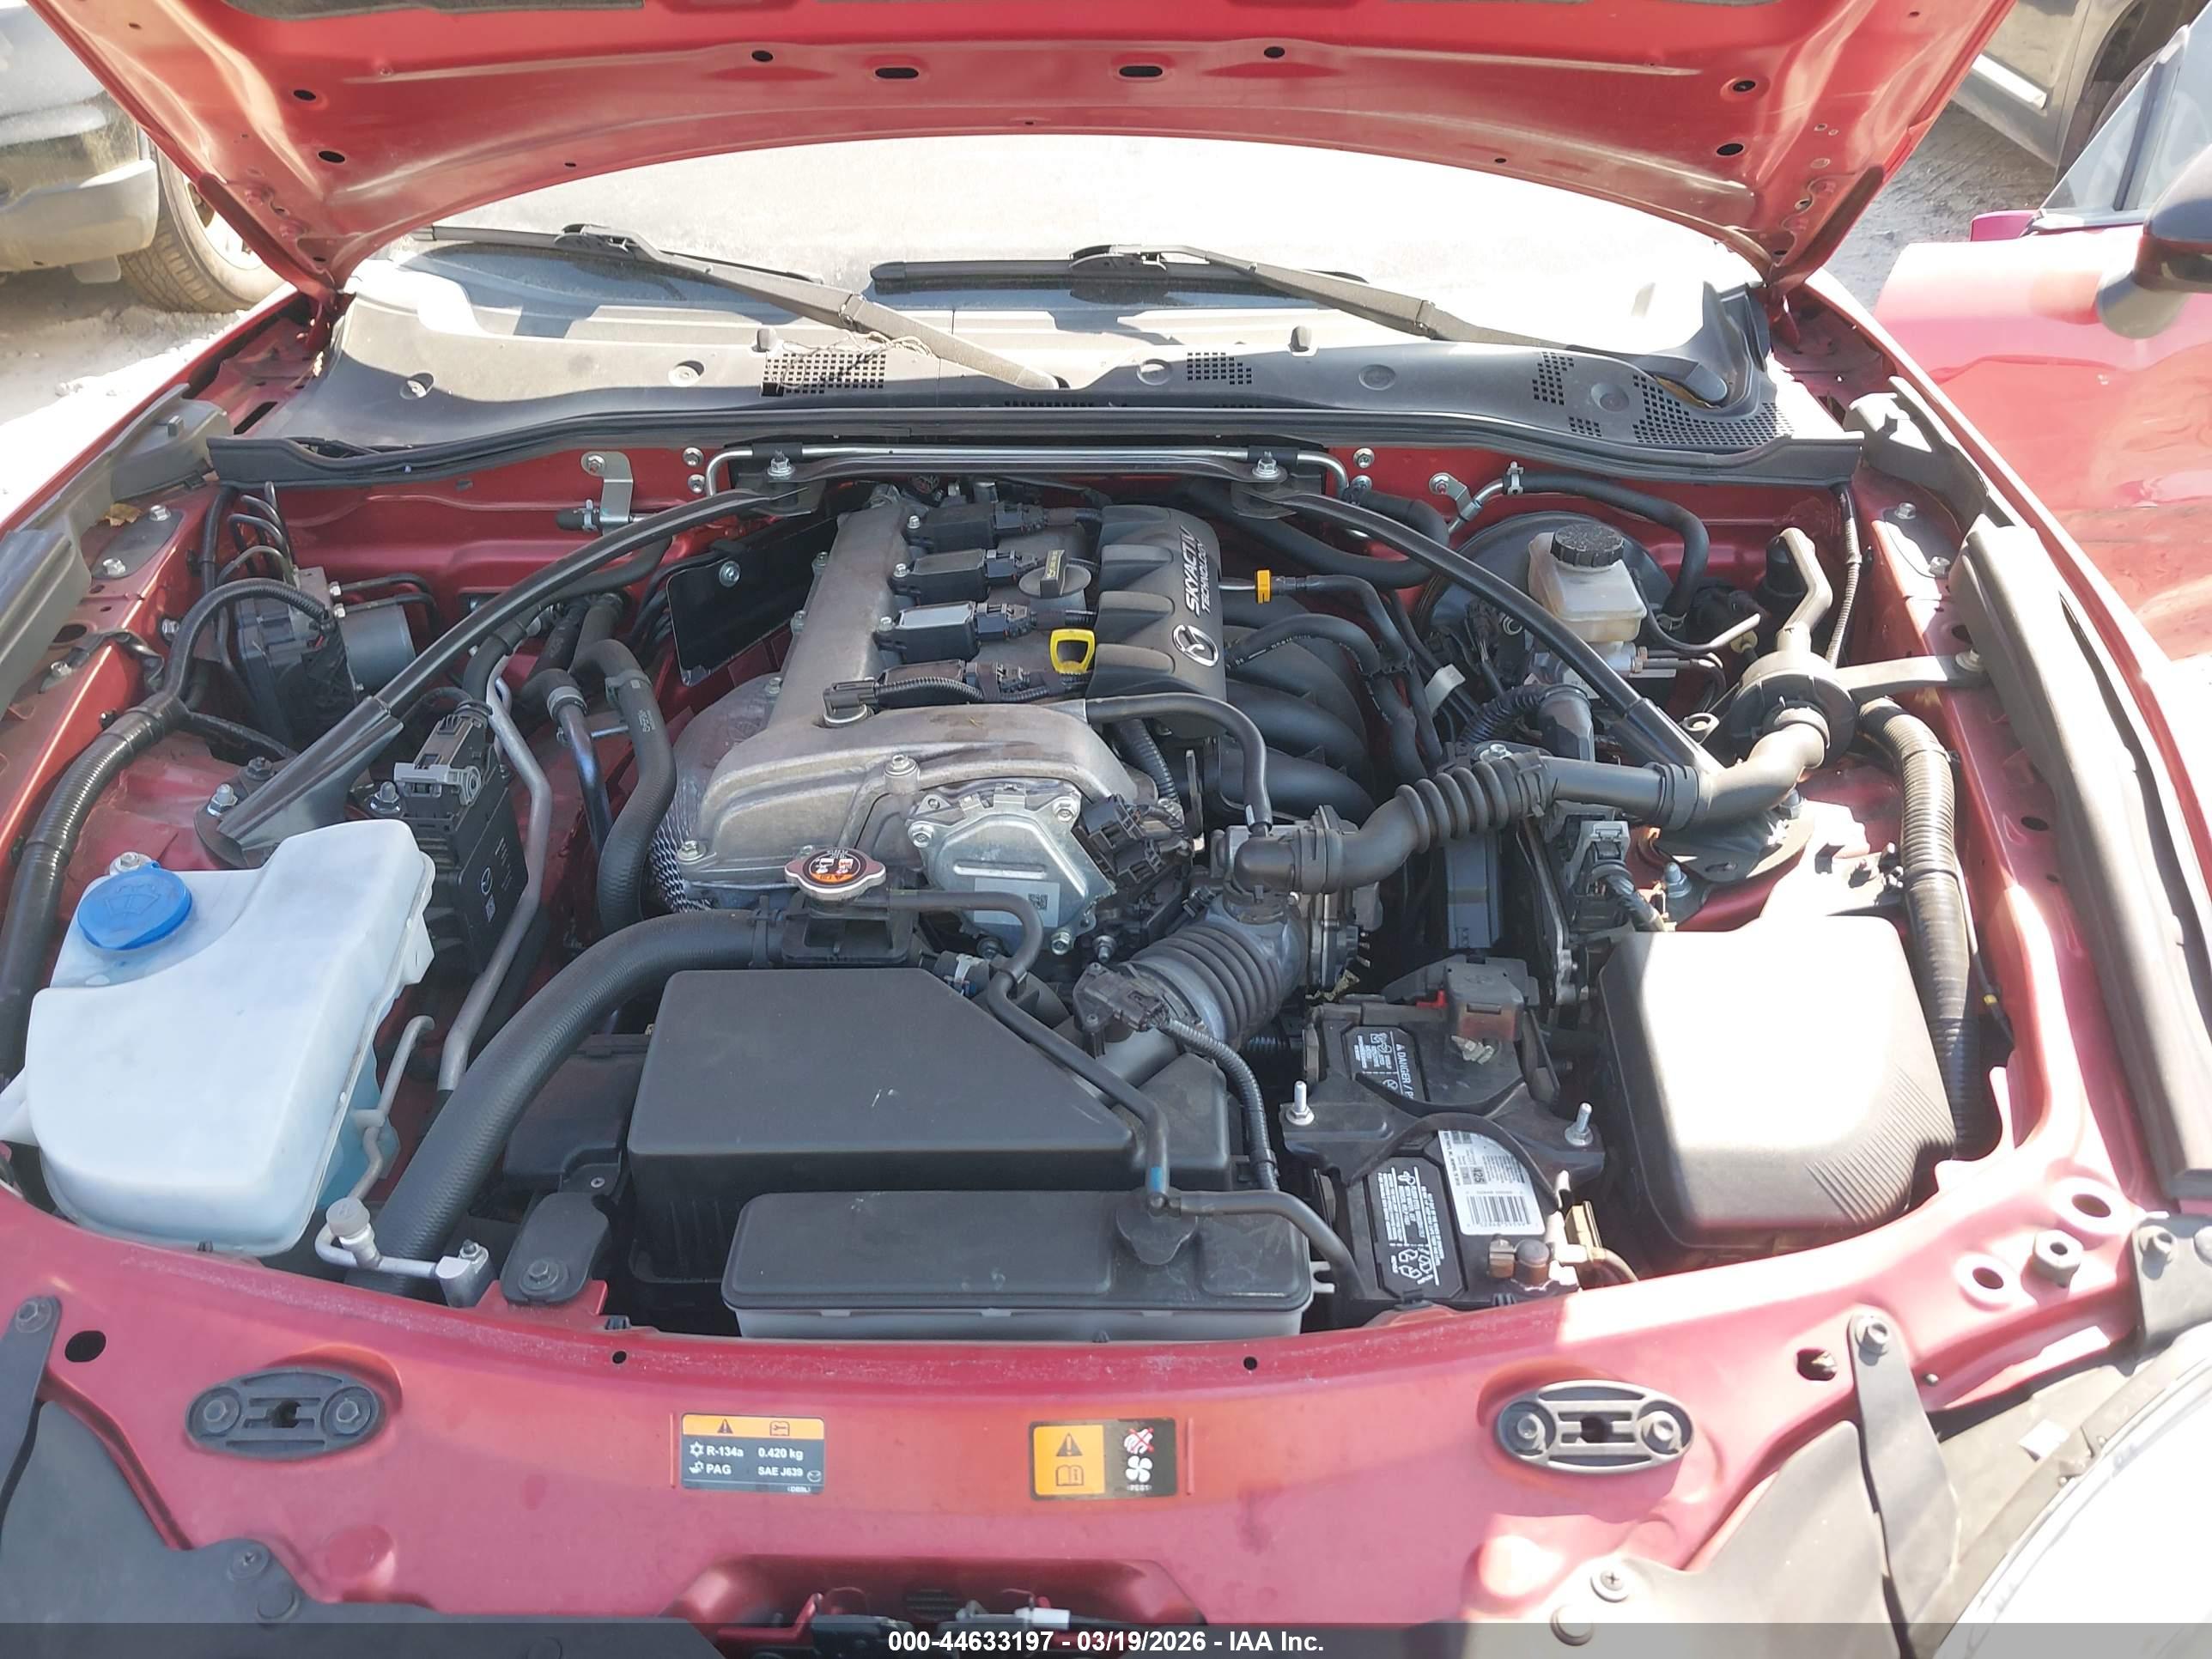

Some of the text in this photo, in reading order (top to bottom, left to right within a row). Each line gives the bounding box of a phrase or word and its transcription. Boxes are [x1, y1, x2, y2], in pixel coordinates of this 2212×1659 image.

[1179, 525, 1200, 617] SKYACTIV
[1195, 538, 1211, 613] TECHNOLOGY
[1396, 1052, 1412, 1084] DANGER
[706, 1445, 804, 1462] R-134a 0.420 kg
[706, 1463, 804, 1478] PAG SAE J639
